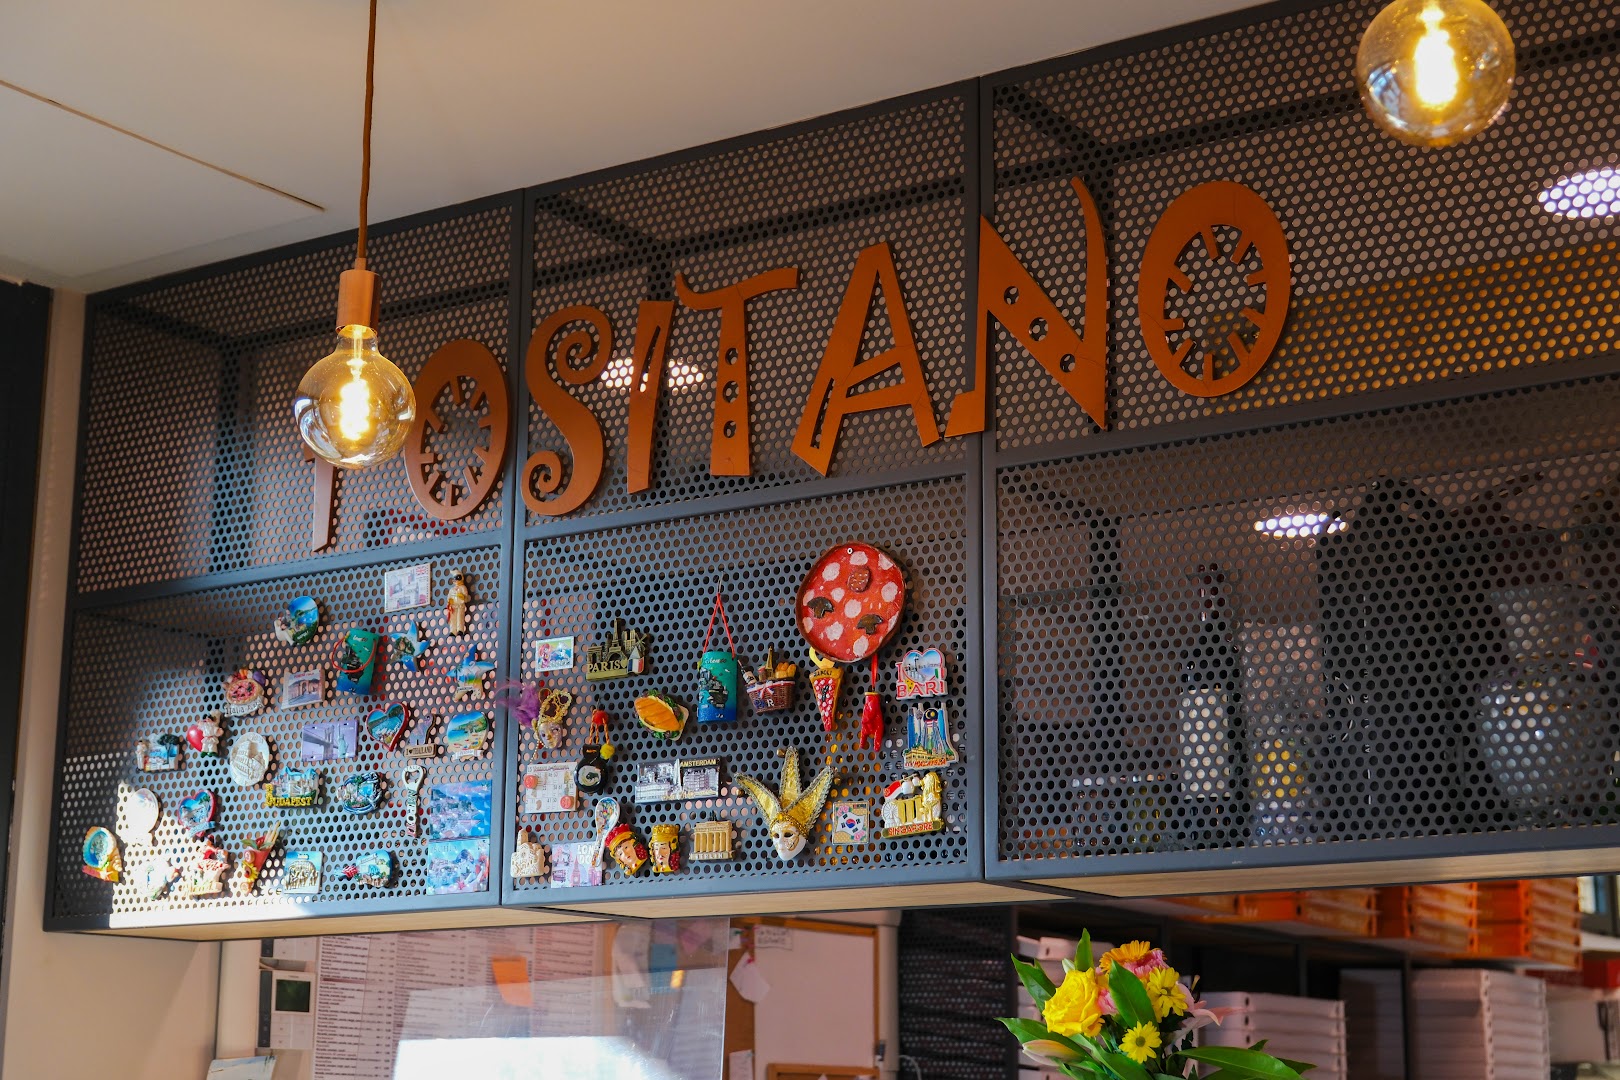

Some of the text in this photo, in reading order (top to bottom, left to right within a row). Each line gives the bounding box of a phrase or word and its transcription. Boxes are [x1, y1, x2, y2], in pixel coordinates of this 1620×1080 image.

[304, 177, 1292, 552] OSITANO
[587, 660, 621, 673] PARIS
[897, 680, 944, 698] BARI
[680, 758, 717, 768] AMSTERDAM
[266, 796, 313, 807] BUDAPEST
[888, 821, 933, 836] SINGAPORE
